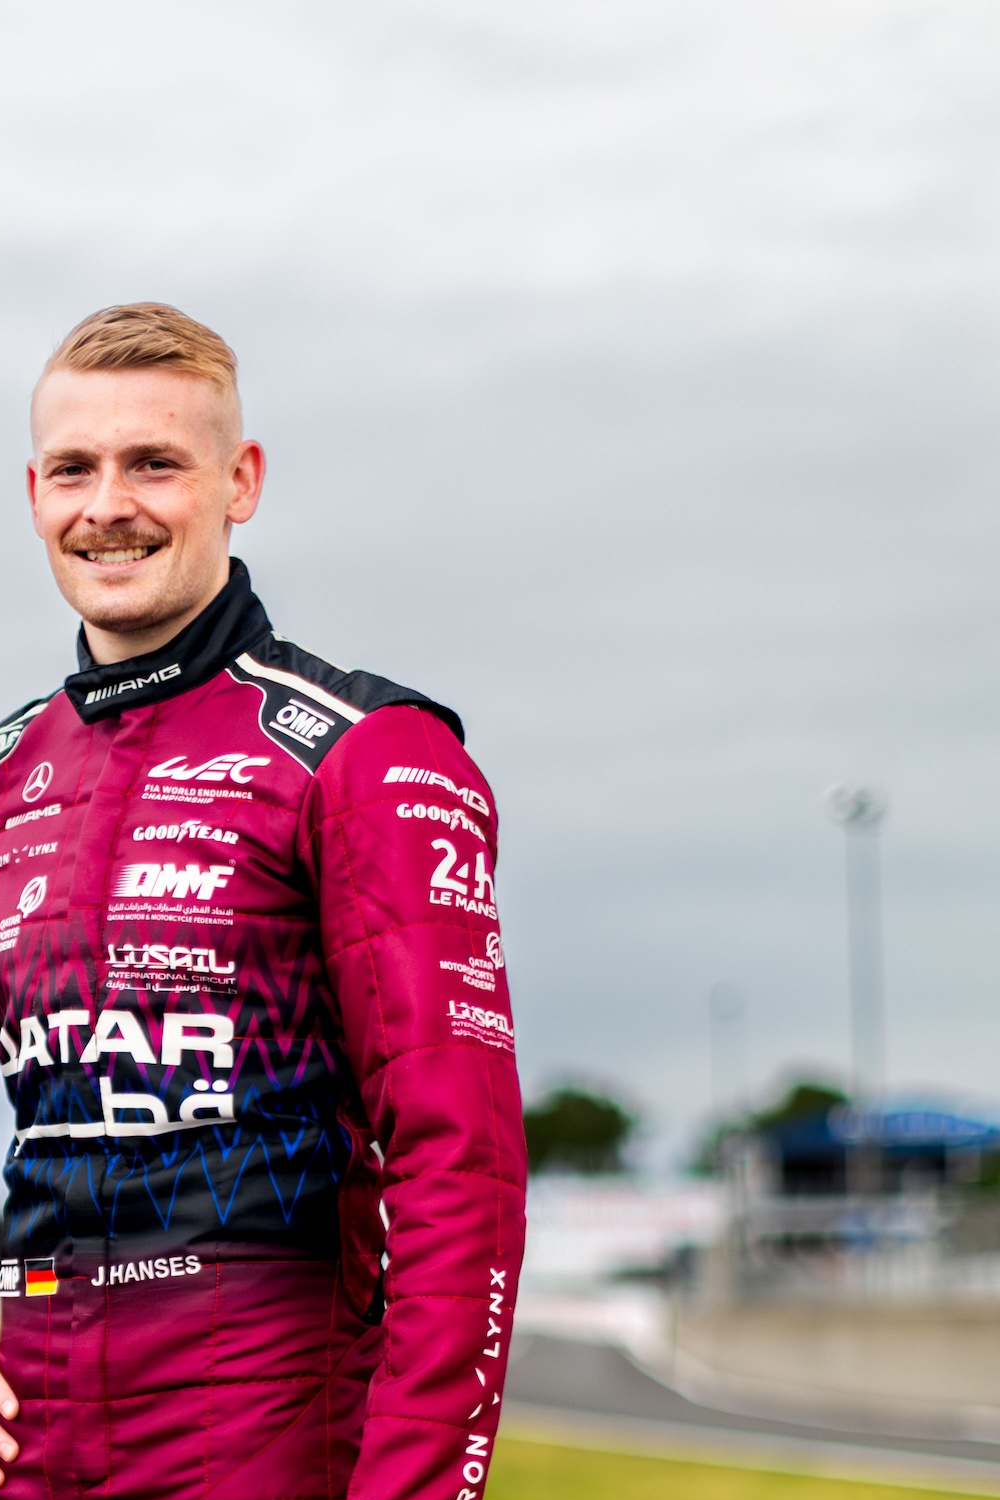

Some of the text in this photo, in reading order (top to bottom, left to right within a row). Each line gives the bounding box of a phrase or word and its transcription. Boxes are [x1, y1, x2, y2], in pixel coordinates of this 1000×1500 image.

[276, 705, 329, 740] OMP
[147, 753, 271, 784] WEC
[141, 793, 215, 804] CHAMPIONSHIP
[144, 784, 253, 800] FIA WORLD ENDURANCE
[132, 820, 240, 845] GOODYEAR
[28, 841, 58, 858] LYNX
[111, 863, 235, 900] QMMF
[429, 890, 498, 920] LE MANS
[151, 914, 193, 924] MOTORCYCLE
[193, 916, 234, 926] FEDERATION
[439, 960, 495, 982] MOTORSPORTS
[468, 956, 494, 971] QATAR
[108, 971, 236, 985] INTERNATIONAL CIRCUIT
[462, 974, 496, 992] ACADEMY
[0, 1266, 20, 1291] OMP
[90, 1255, 201, 1287] J.HANSES
[483, 1267, 507, 1358] LYNX
